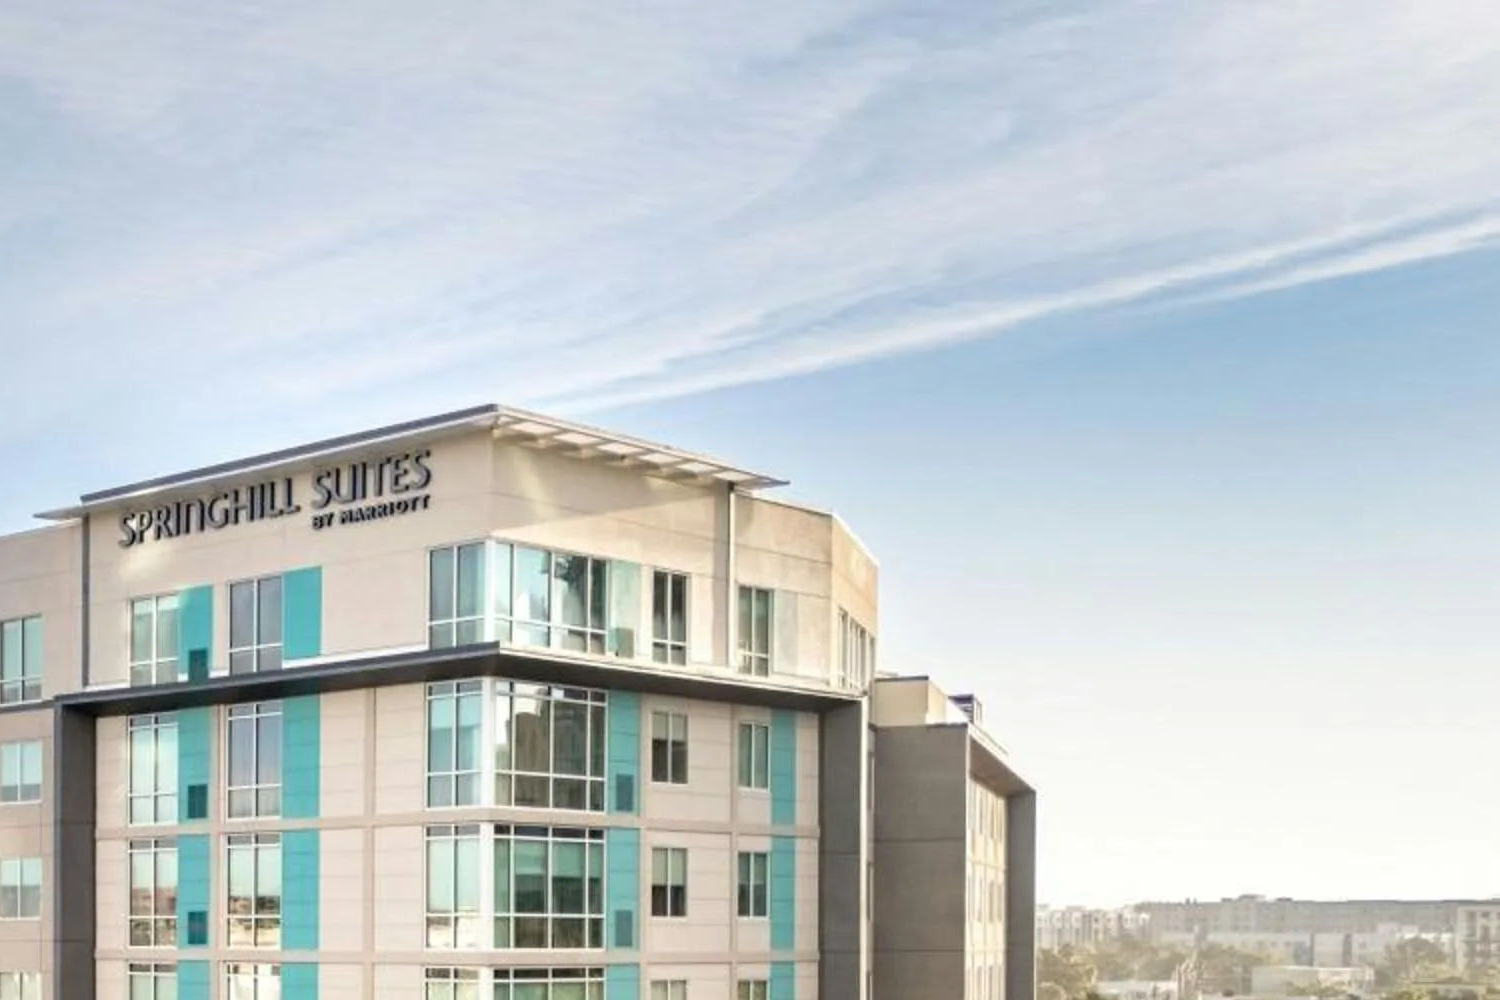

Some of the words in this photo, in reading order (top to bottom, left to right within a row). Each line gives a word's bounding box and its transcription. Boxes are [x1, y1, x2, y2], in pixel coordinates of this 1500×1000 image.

[119, 479, 302, 547] SPRINGHILL
[312, 450, 432, 508] SUITES
[312, 513, 335, 530] BY
[340, 493, 431, 525] MARRIOTT
